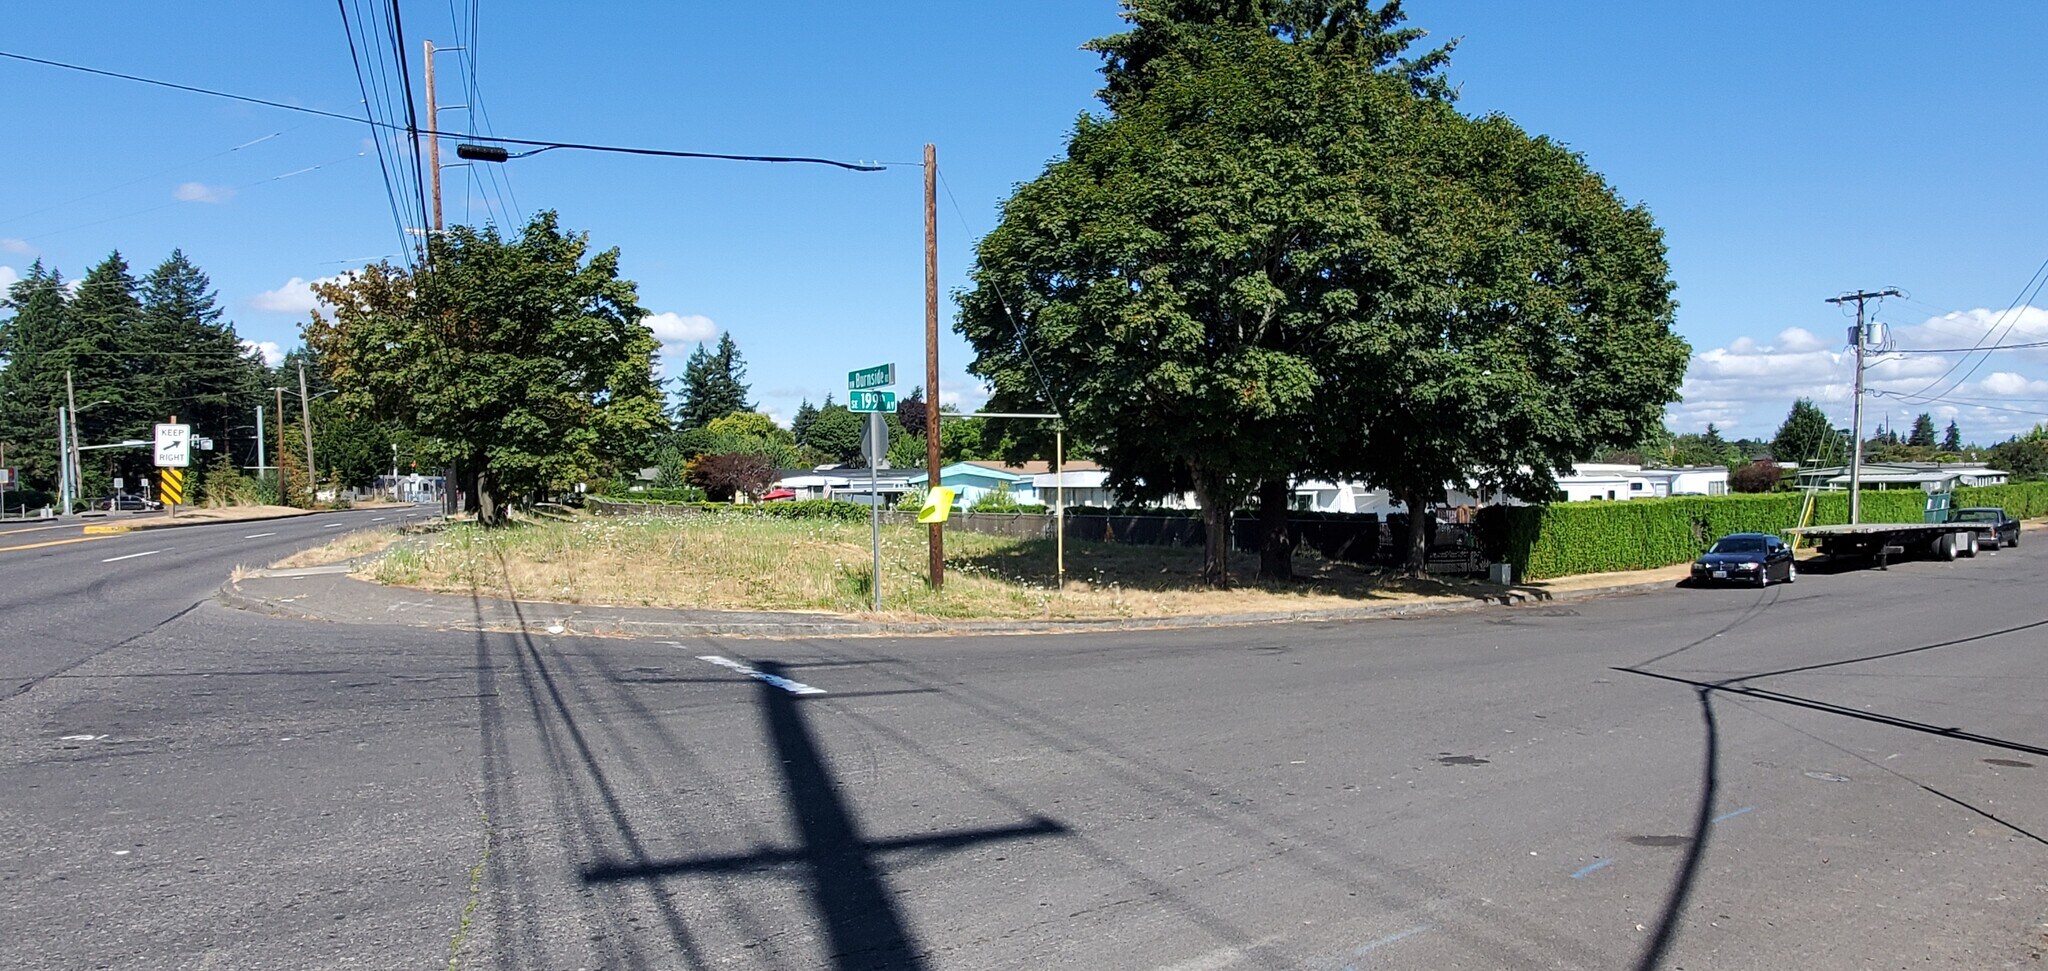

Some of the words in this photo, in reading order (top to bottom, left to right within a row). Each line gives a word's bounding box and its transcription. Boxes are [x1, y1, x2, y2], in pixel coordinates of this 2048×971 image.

[855, 368, 884, 388] Burnside
[851, 400, 858, 409] SE
[886, 401, 895, 410] AV
